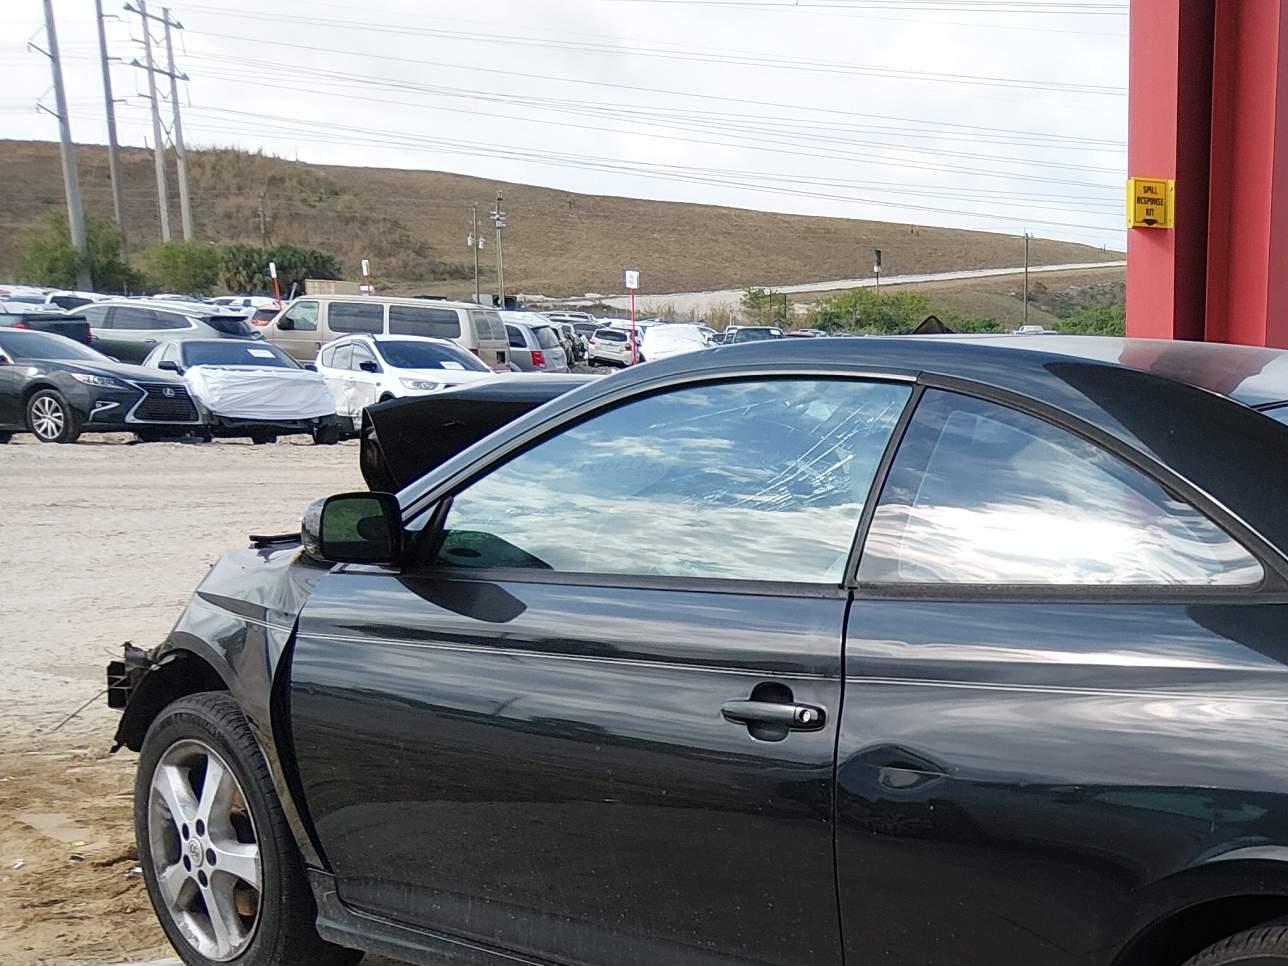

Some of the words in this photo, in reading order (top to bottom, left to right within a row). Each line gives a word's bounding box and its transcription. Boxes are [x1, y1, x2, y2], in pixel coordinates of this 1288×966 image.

[1143, 186, 1158, 195] SPILL
[1136, 196, 1164, 206] RESPONSE
[1145, 208, 1154, 216] KIT
